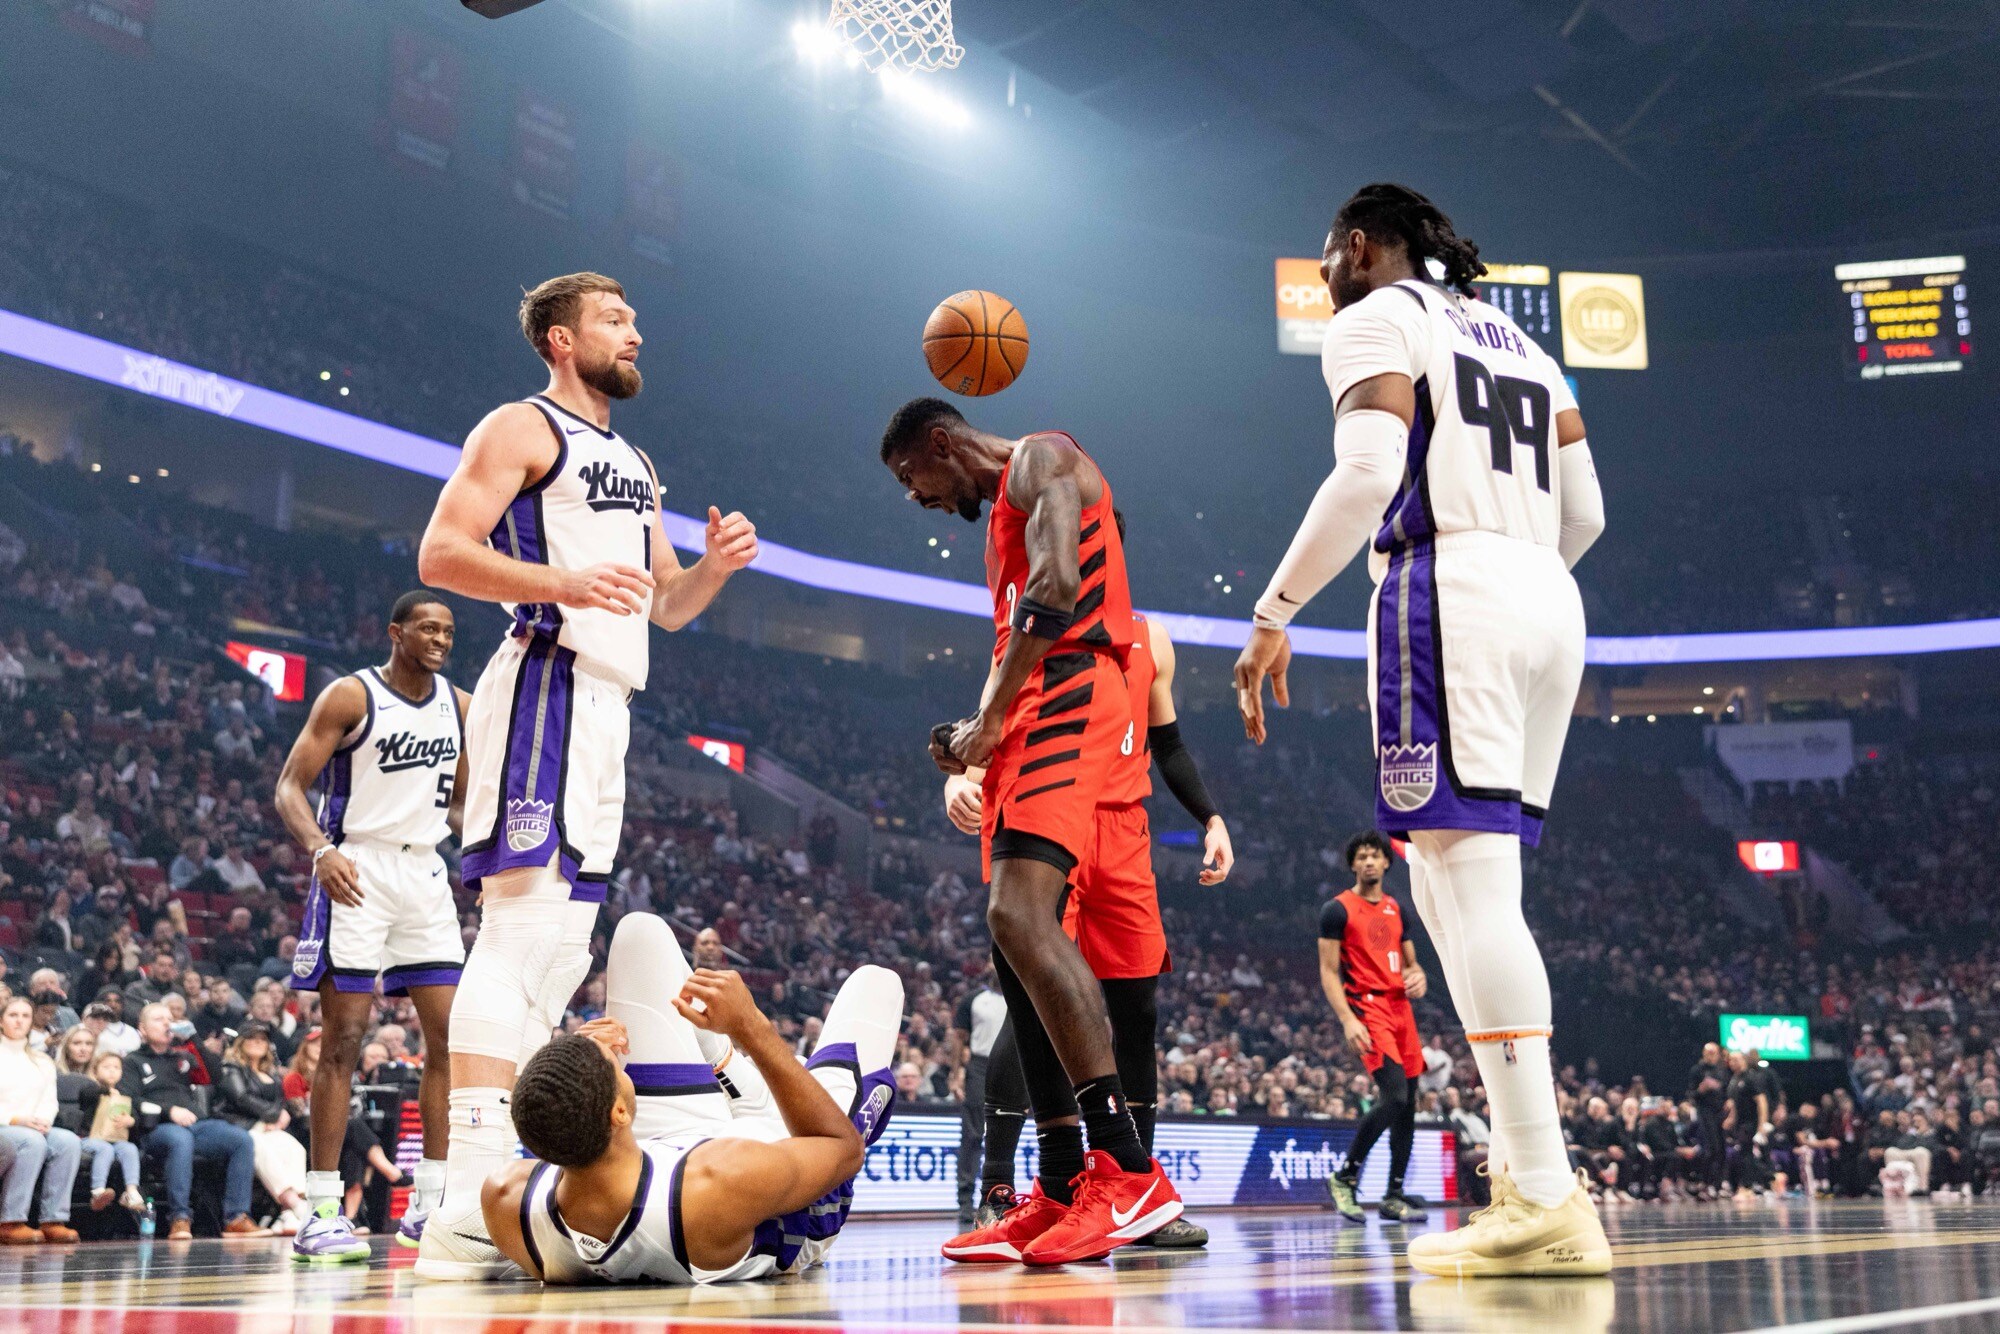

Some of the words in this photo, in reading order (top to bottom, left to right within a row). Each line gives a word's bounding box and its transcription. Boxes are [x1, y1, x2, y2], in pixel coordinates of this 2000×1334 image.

[1876, 322, 1938, 340] STEALS
[1883, 343, 1934, 359] TOTAL
[122, 355, 244, 417] xfinity
[1453, 351, 1551, 494] 99
[578, 461, 655, 515] Kings
[375, 731, 457, 774] Kings
[434, 772, 455, 809] 5
[1383, 771, 1433, 785] KINGS
[508, 819, 549, 834] KINGS
[1726, 1017, 1806, 1054] Sprite
[1269, 1138, 1347, 1190] xfinity
[579, 1236, 602, 1249] NIKE
